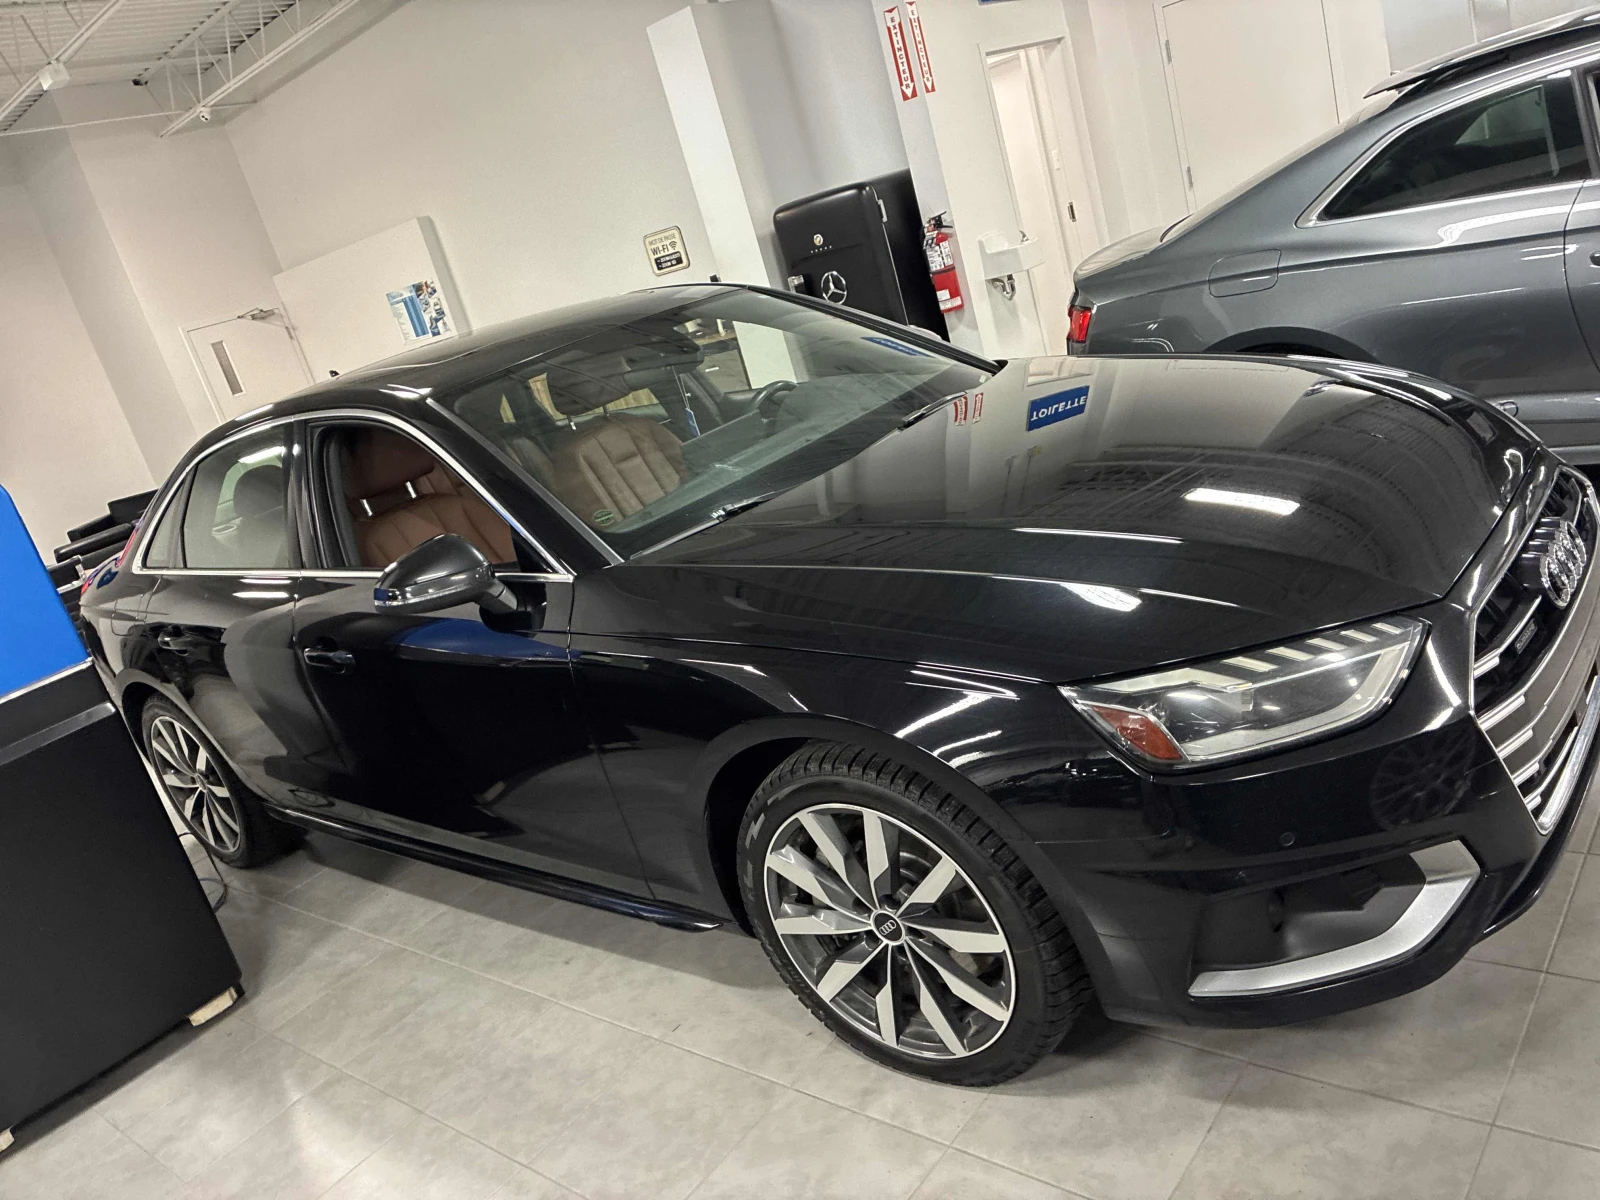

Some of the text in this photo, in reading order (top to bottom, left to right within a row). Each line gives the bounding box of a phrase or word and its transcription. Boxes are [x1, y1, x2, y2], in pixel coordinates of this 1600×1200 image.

[890, 17, 911, 89] EXTINCTEUR
[911, 10, 931, 82] EXTINCTEUR
[651, 244, 669, 256] WI-FI
